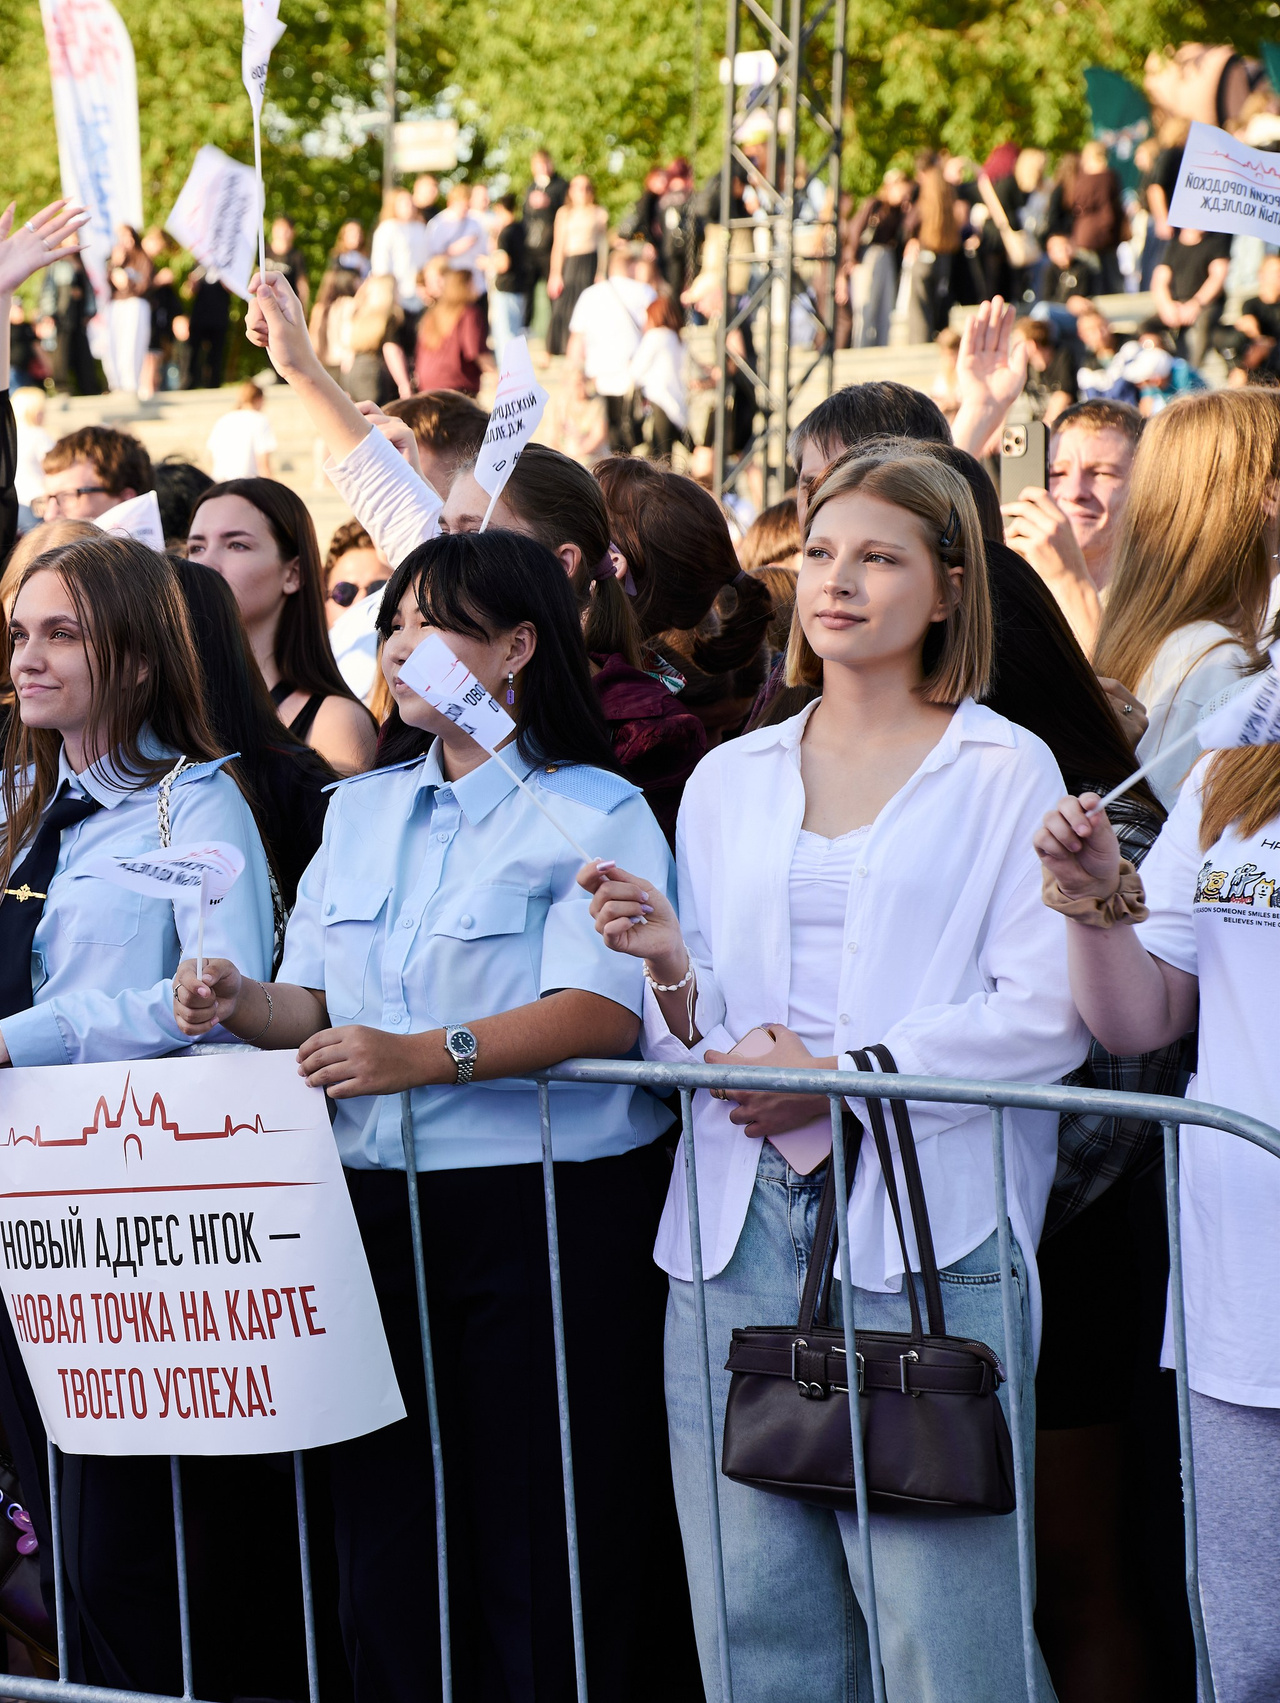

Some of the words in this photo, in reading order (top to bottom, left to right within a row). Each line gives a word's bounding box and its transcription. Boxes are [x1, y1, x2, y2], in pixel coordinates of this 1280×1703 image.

[1213, 906, 1246, 916] SOMEONE
[1248, 910, 1271, 919] SMILES
[1223, 916, 1254, 926] BELIEVES
[0, 1206, 86, 1270] НОВЫЙ
[96, 1214, 183, 1278] АДРЕС
[189, 1212, 262, 1265] НГОК
[11, 1293, 87, 1344] НОВАЯ
[90, 1291, 176, 1344] ТОЧКА
[180, 1290, 220, 1343] НА
[224, 1285, 326, 1341] КАРТЕ
[57, 1367, 148, 1420] ТВОЕГО
[153, 1365, 277, 1420] УСПЕХА!
